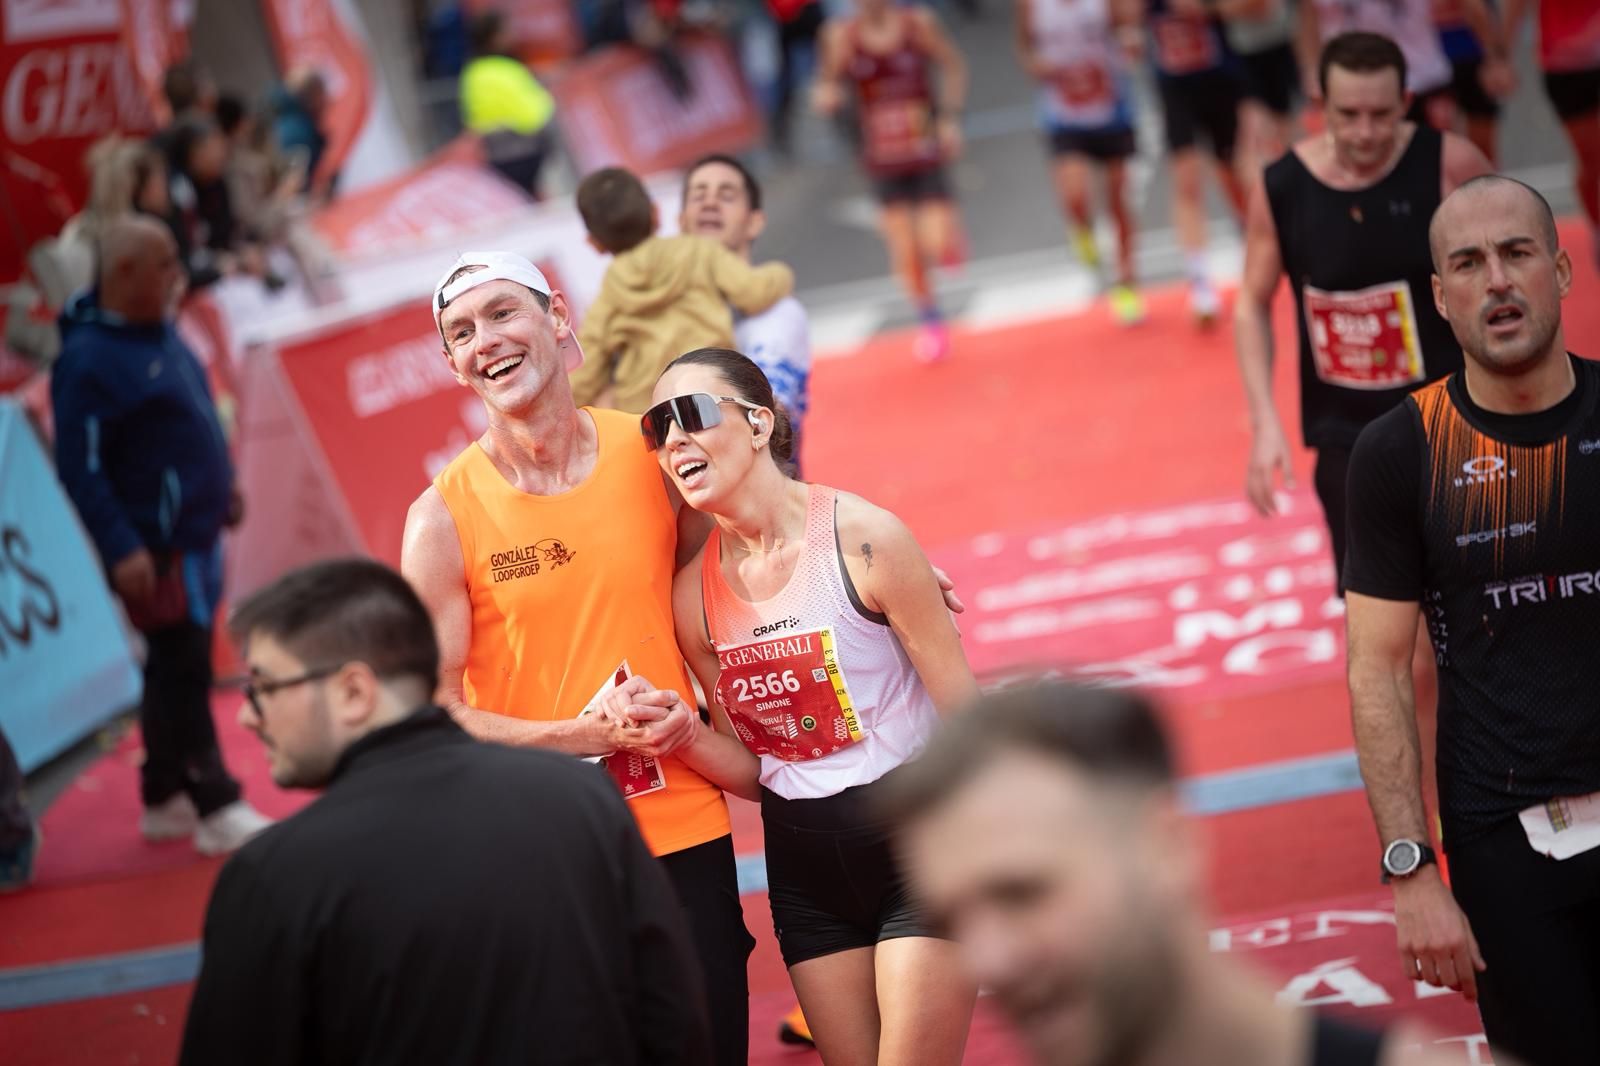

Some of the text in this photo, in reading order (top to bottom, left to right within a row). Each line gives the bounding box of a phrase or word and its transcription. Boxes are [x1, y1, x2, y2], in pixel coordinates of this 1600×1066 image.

[491, 545, 537, 567] GONZÁLEZ
[493, 563, 540, 583] LOOPGROEP
[753, 619, 788, 637] CRAFT
[726, 636, 813, 667] GENERALI
[732, 669, 801, 703] 2566
[756, 697, 792, 712] SIMONE
[846, 714, 859, 732] BOX
